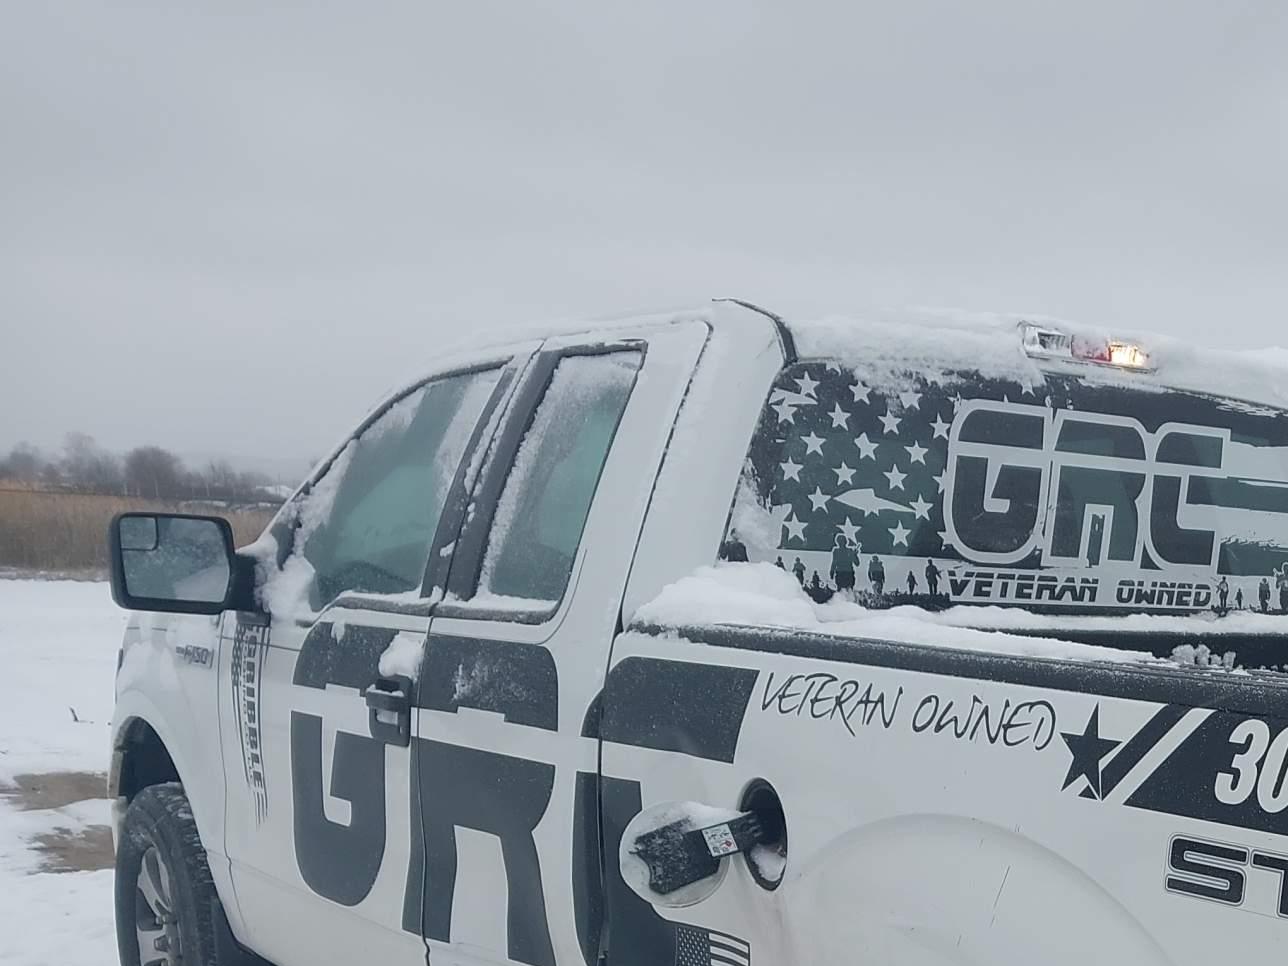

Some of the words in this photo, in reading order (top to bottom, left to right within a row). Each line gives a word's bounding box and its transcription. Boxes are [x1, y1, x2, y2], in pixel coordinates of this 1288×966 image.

[943, 398, 1232, 573] GRC
[947, 569, 1099, 602] VETERAN
[1115, 579, 1211, 607] OWNED
[761, 672, 903, 737] VETERAN
[911, 694, 1056, 751] OWNED
